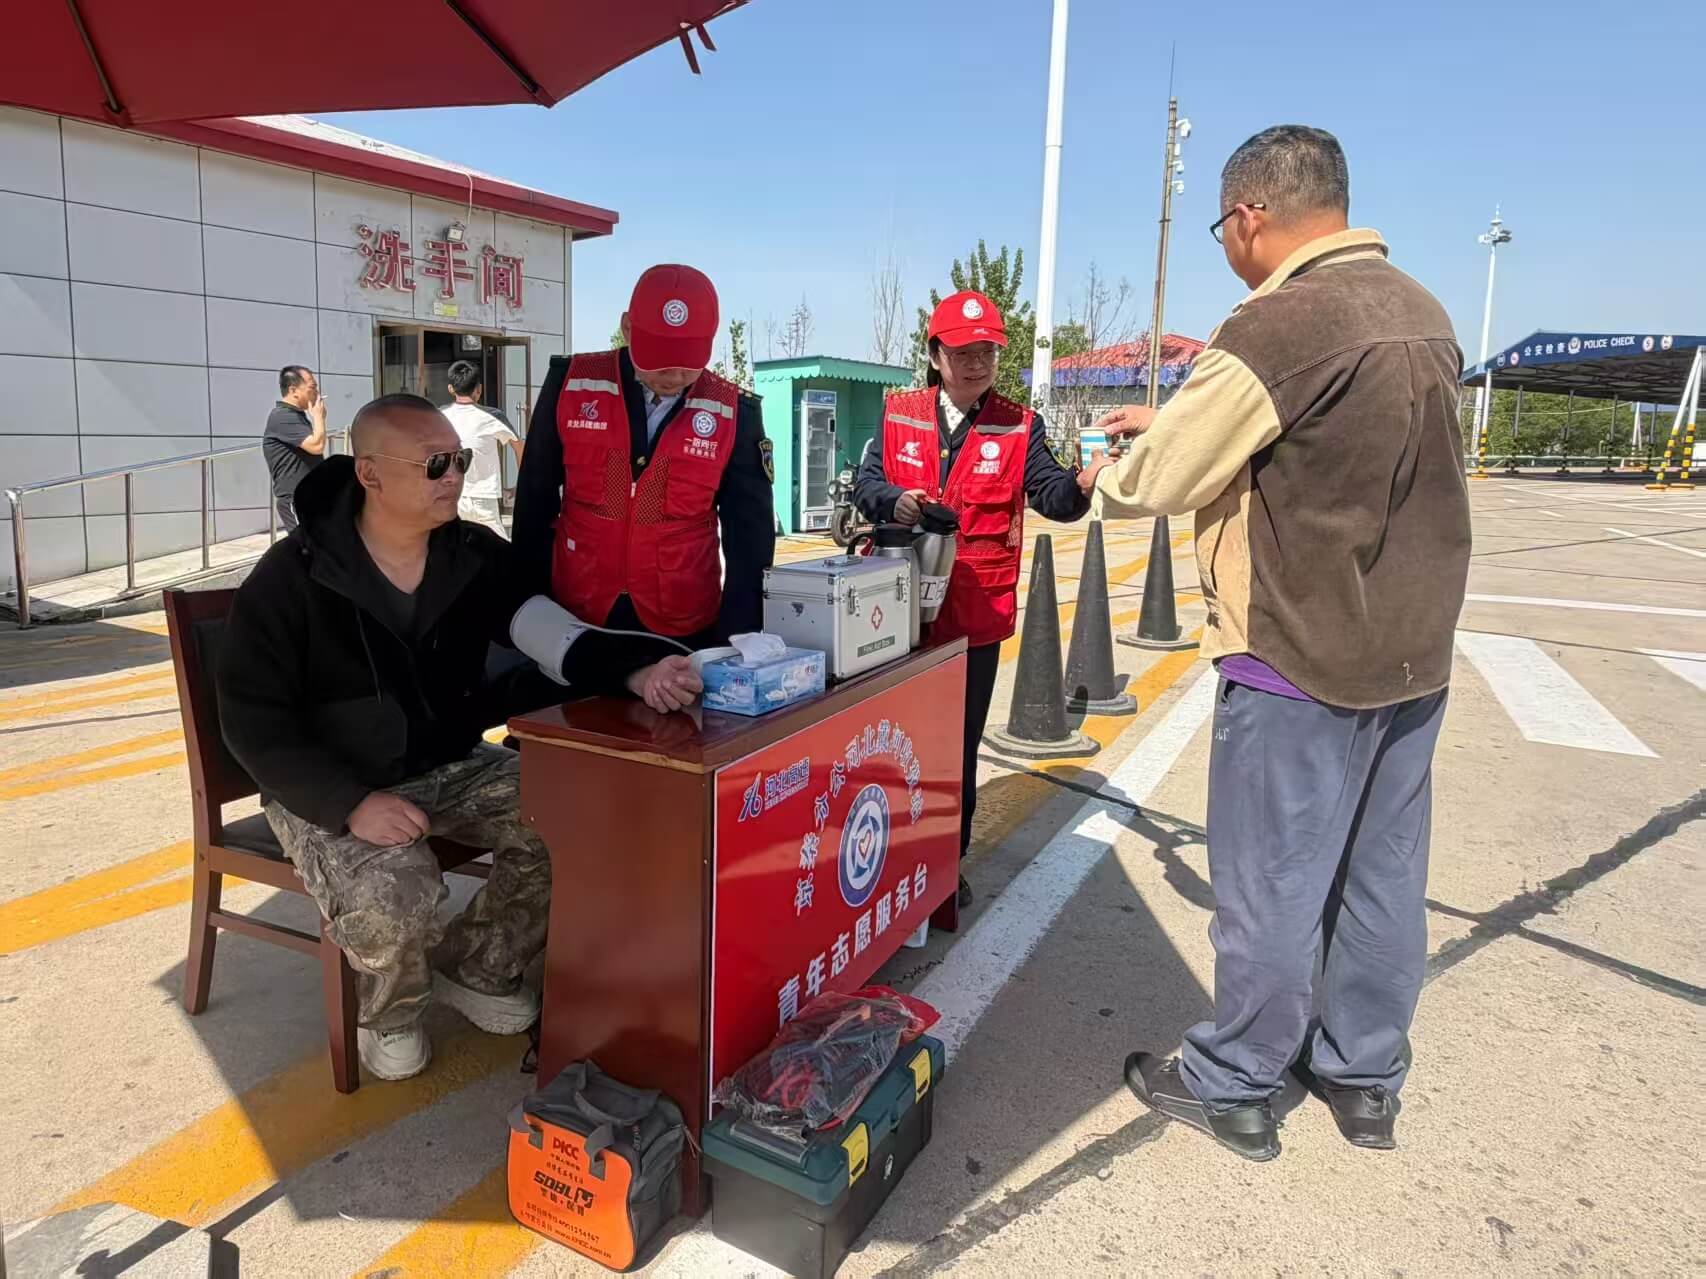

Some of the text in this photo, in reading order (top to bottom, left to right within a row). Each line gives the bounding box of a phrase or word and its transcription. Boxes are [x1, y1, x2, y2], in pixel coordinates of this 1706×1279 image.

[358, 223, 525, 309] 洗手间
[1524, 343, 1565, 356] 公安检查
[1584, 336, 1635, 349] POLICE CHECK
[764, 757, 810, 801] 河北高速
[777, 862, 928, 1028] 青年志愿服务台
[552, 1136, 580, 1160] PICC
